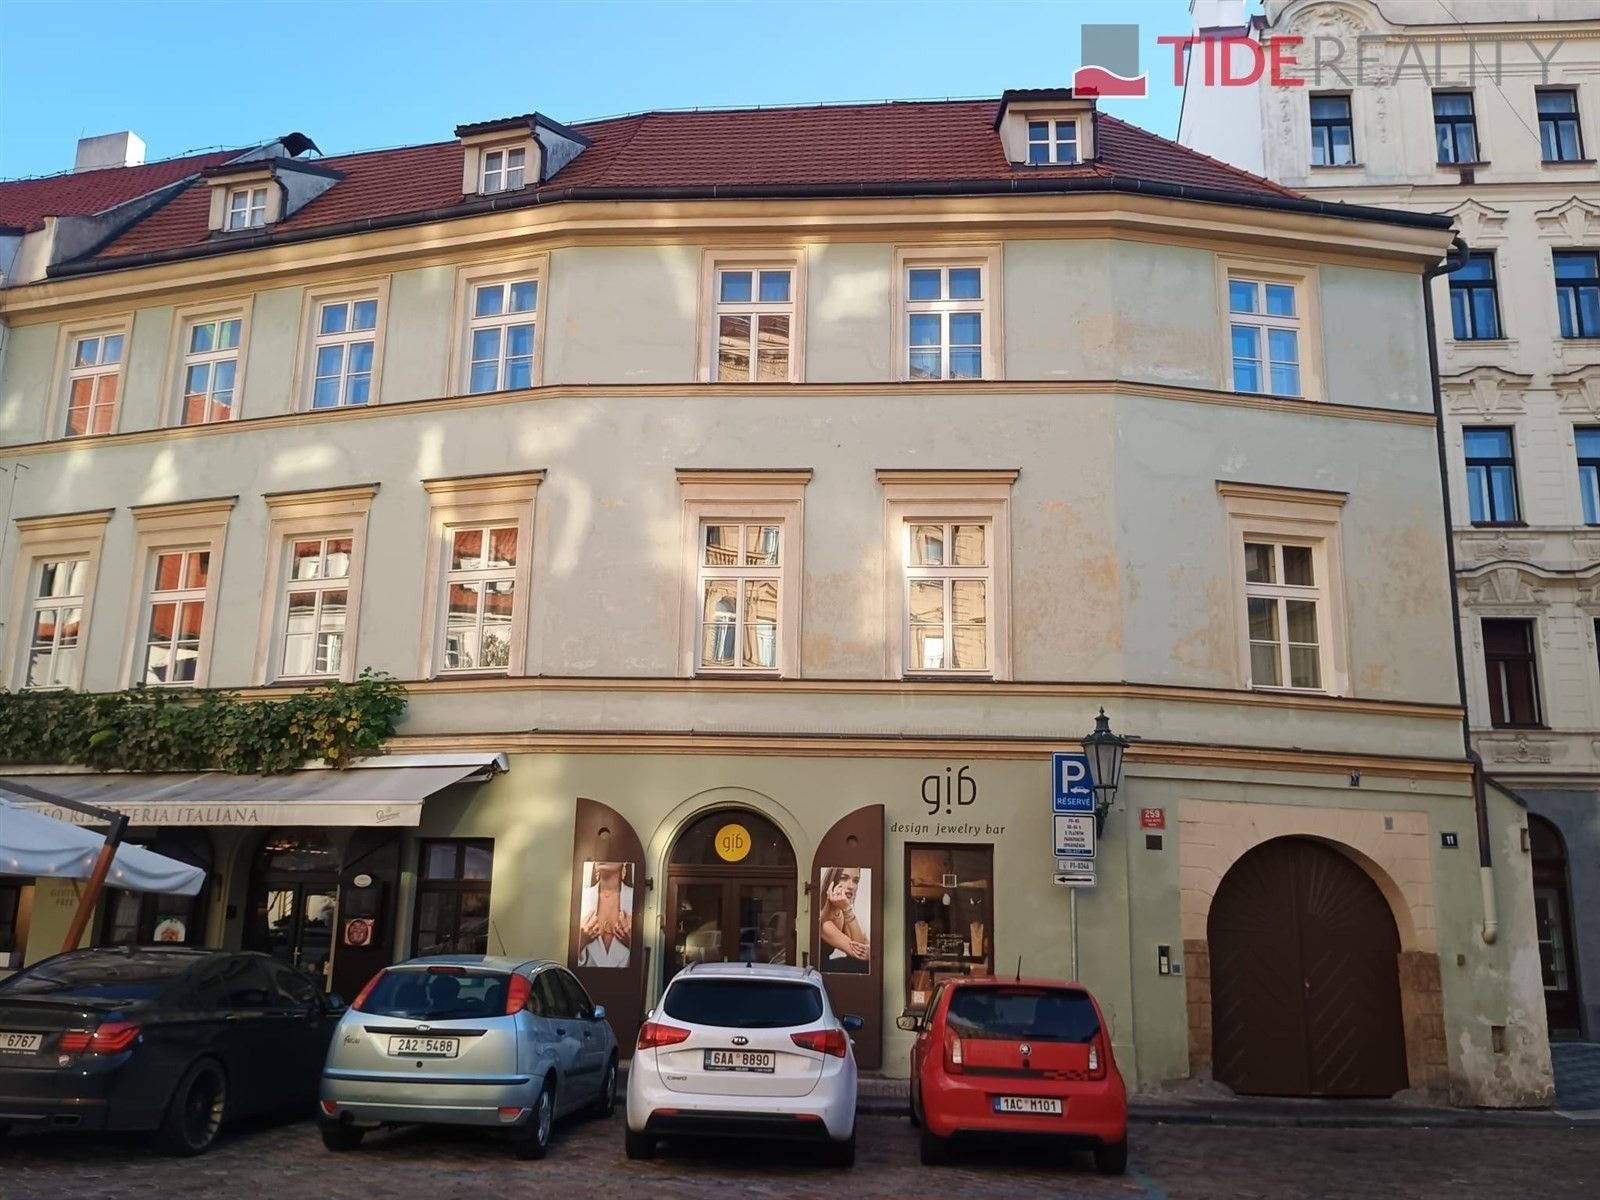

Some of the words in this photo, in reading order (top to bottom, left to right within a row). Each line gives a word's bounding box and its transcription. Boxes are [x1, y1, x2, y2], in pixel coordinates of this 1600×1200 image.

[1062, 760, 1085, 793] P
[922, 765, 976, 815] gib
[177, 807, 258, 822] ITALIANA
[1145, 809, 1160, 818] 259
[890, 822, 929, 835] design
[935, 823, 981, 836] jewelry
[985, 824, 1006, 834] bar
[1446, 835, 1454, 845] 11
[8, 1034, 37, 1048] 6767
[398, 1039, 418, 1051] 2A2
[426, 1039, 453, 1052] 5488
[713, 1052, 734, 1065] 6AA
[742, 1053, 769, 1066] 8890
[1003, 1098, 1023, 1110] 1AC
